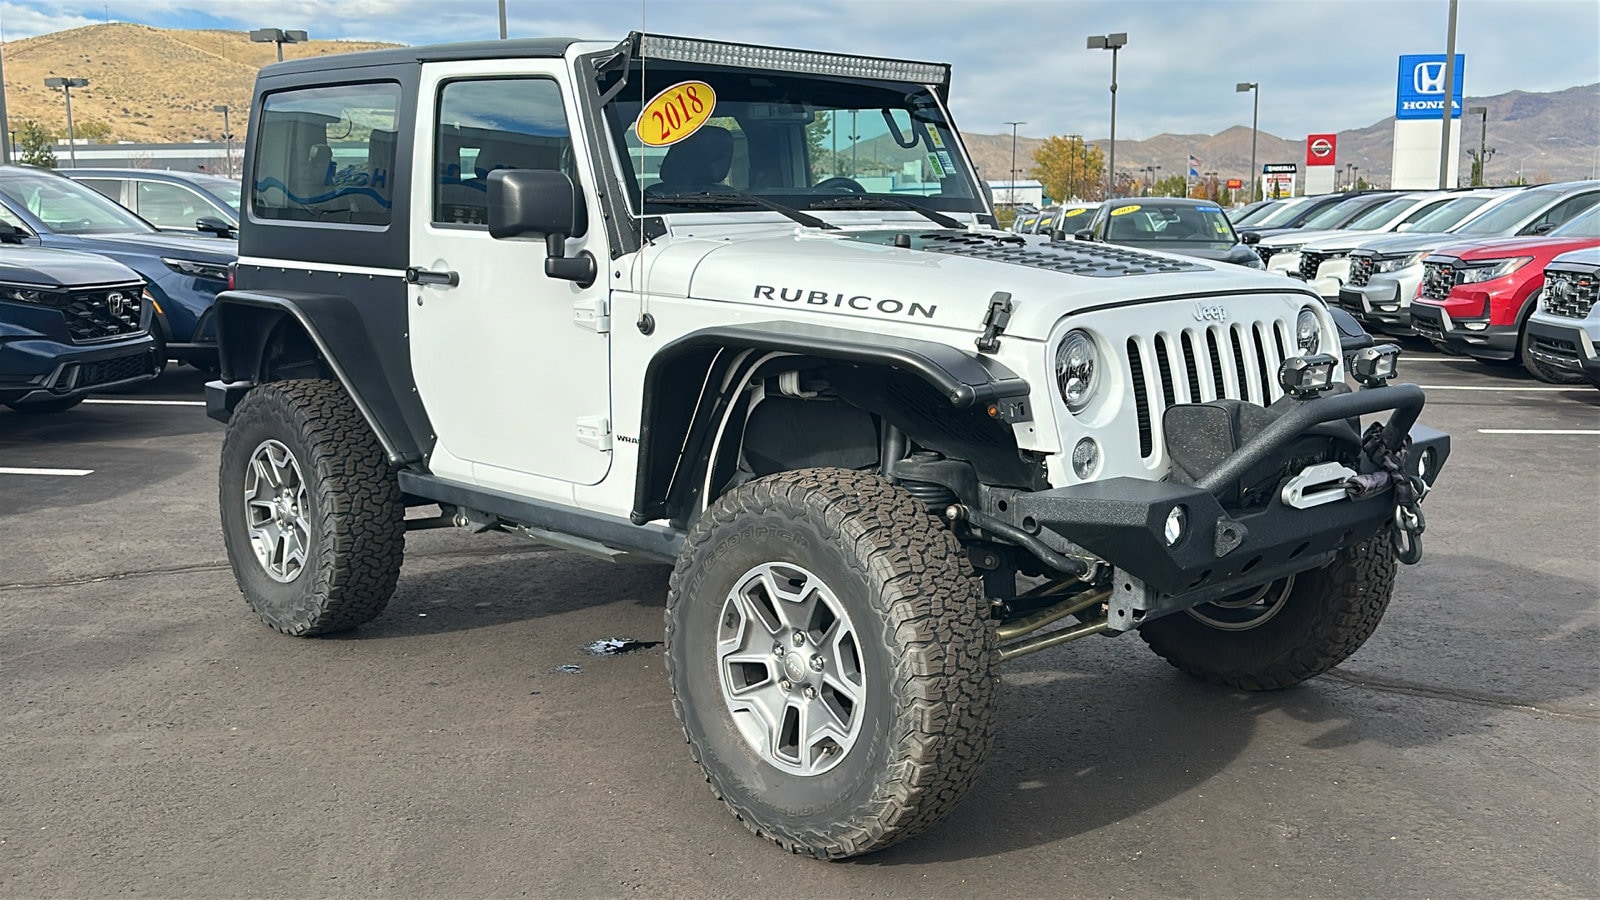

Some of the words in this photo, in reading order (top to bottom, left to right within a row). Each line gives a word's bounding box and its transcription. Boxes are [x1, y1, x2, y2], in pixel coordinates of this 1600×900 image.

[652, 86, 704, 140] 2018
[753, 285, 937, 318] RUBICON
[1192, 301, 1226, 323] Jeep
